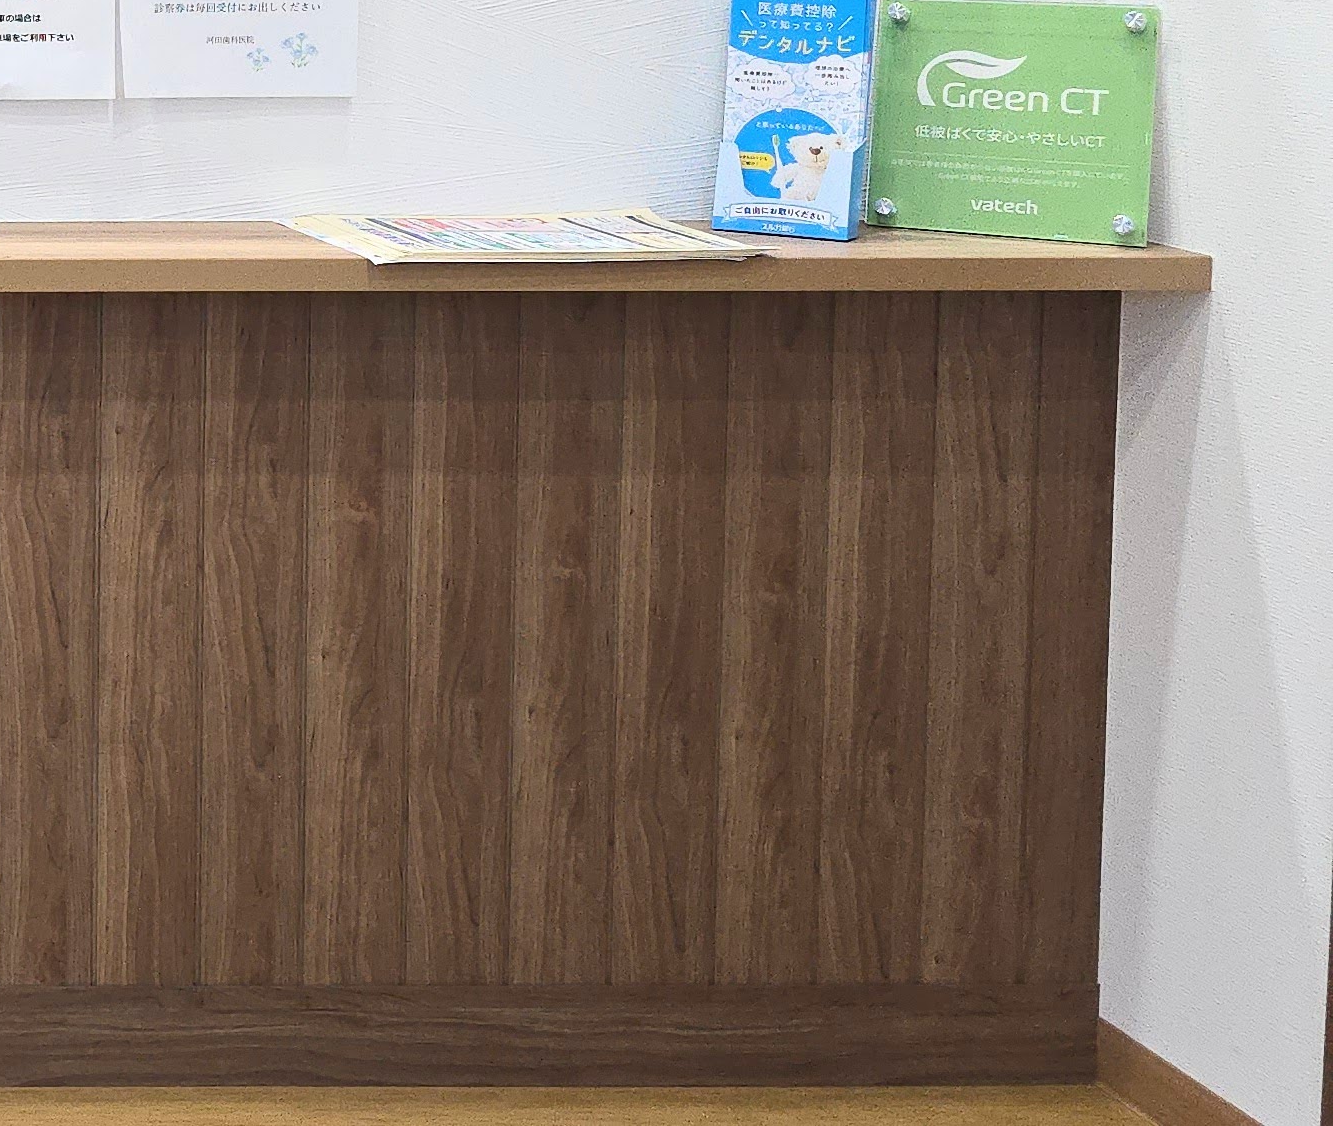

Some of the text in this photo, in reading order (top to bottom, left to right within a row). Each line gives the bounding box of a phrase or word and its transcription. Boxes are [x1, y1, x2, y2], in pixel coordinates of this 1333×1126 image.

[758, 2, 837, 19] 医療費控除
[738, 29, 856, 56] デンタルナビ
[943, 82, 1110, 116] Green CT
[915, 124, 1107, 149] 低被ばくで安心・やさしいCT
[735, 207, 825, 221] ご自由にお取りください
[970, 198, 1039, 215] vatech
